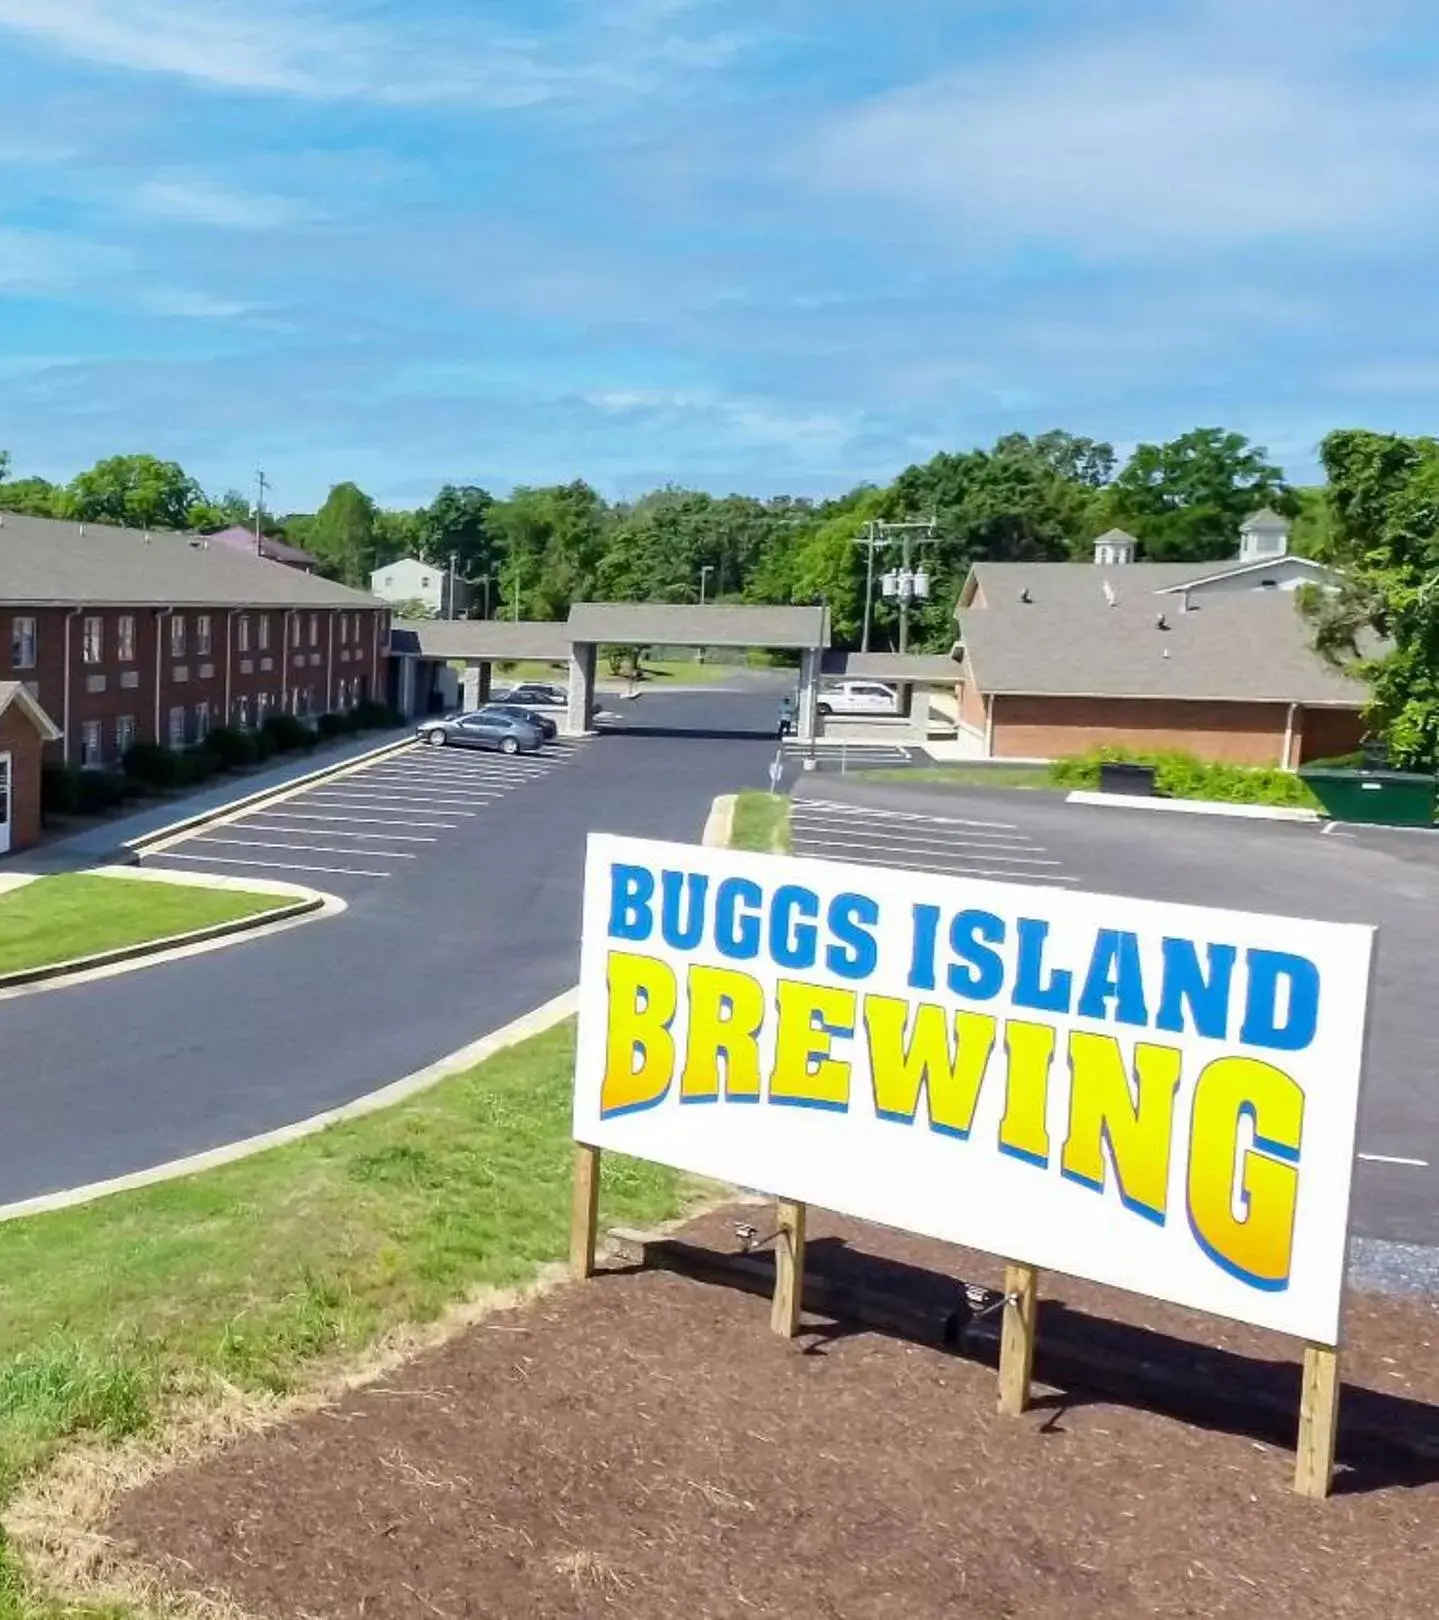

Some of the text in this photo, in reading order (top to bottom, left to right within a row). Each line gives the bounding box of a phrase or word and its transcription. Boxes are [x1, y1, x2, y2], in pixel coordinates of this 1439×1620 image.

[607, 863, 1321, 1052] BUGGS ISLAND
[600, 950, 1306, 1293] BREWING
